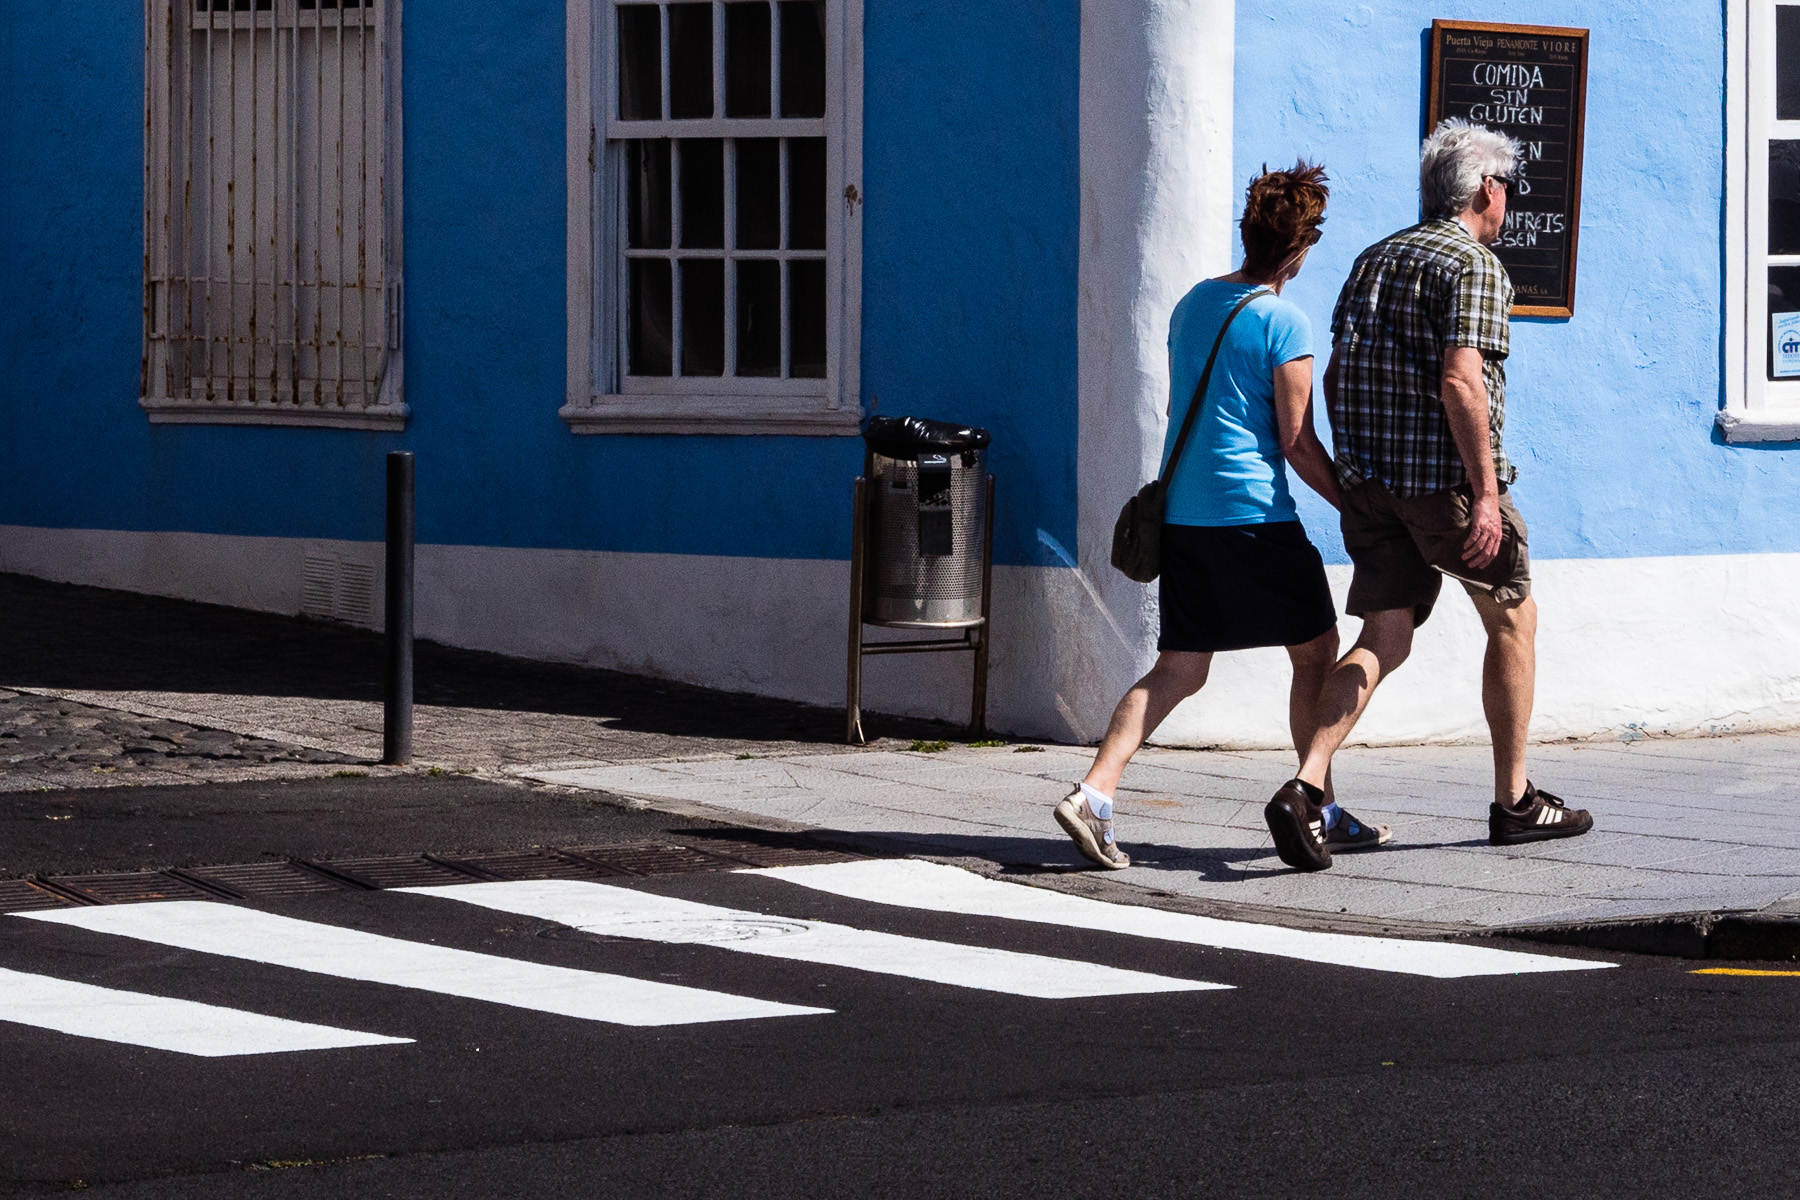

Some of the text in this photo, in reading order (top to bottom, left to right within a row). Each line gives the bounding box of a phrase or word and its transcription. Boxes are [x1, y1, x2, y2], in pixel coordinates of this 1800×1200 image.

[1446, 34, 1471, 46] Puerta
[1473, 35, 1493, 49] Vieja
[1542, 41, 1577, 53] VIORE
[1472, 62, 1544, 89] COMIDA
[1490, 88, 1528, 107] SIN
[1469, 103, 1543, 125] GLUTEN
